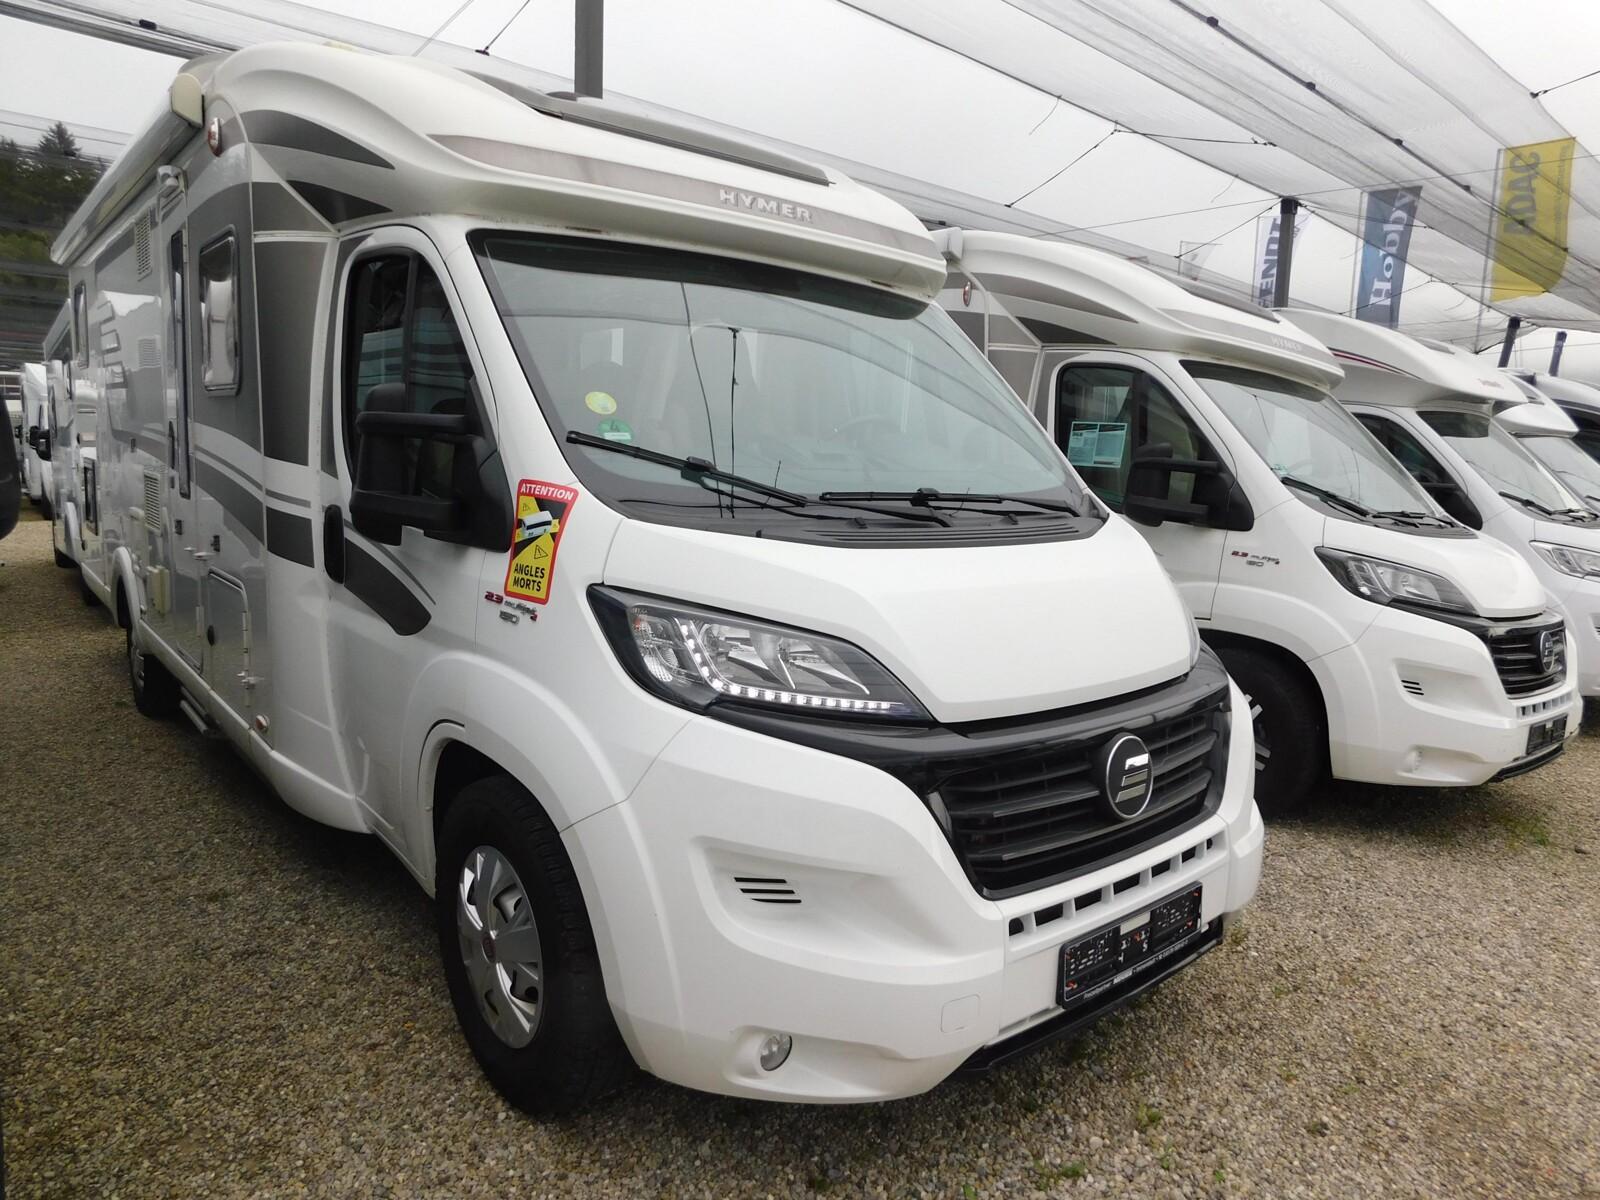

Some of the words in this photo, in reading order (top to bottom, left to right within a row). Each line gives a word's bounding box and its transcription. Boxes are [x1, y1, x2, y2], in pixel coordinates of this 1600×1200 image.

[719, 188, 812, 222] HYMER
[1502, 151, 1541, 237] ADAC
[1369, 189, 1418, 307] Hobby
[520, 483, 574, 501] ATTENTION
[512, 575, 542, 592] MORTS
[513, 563, 546, 579] ANGLES
